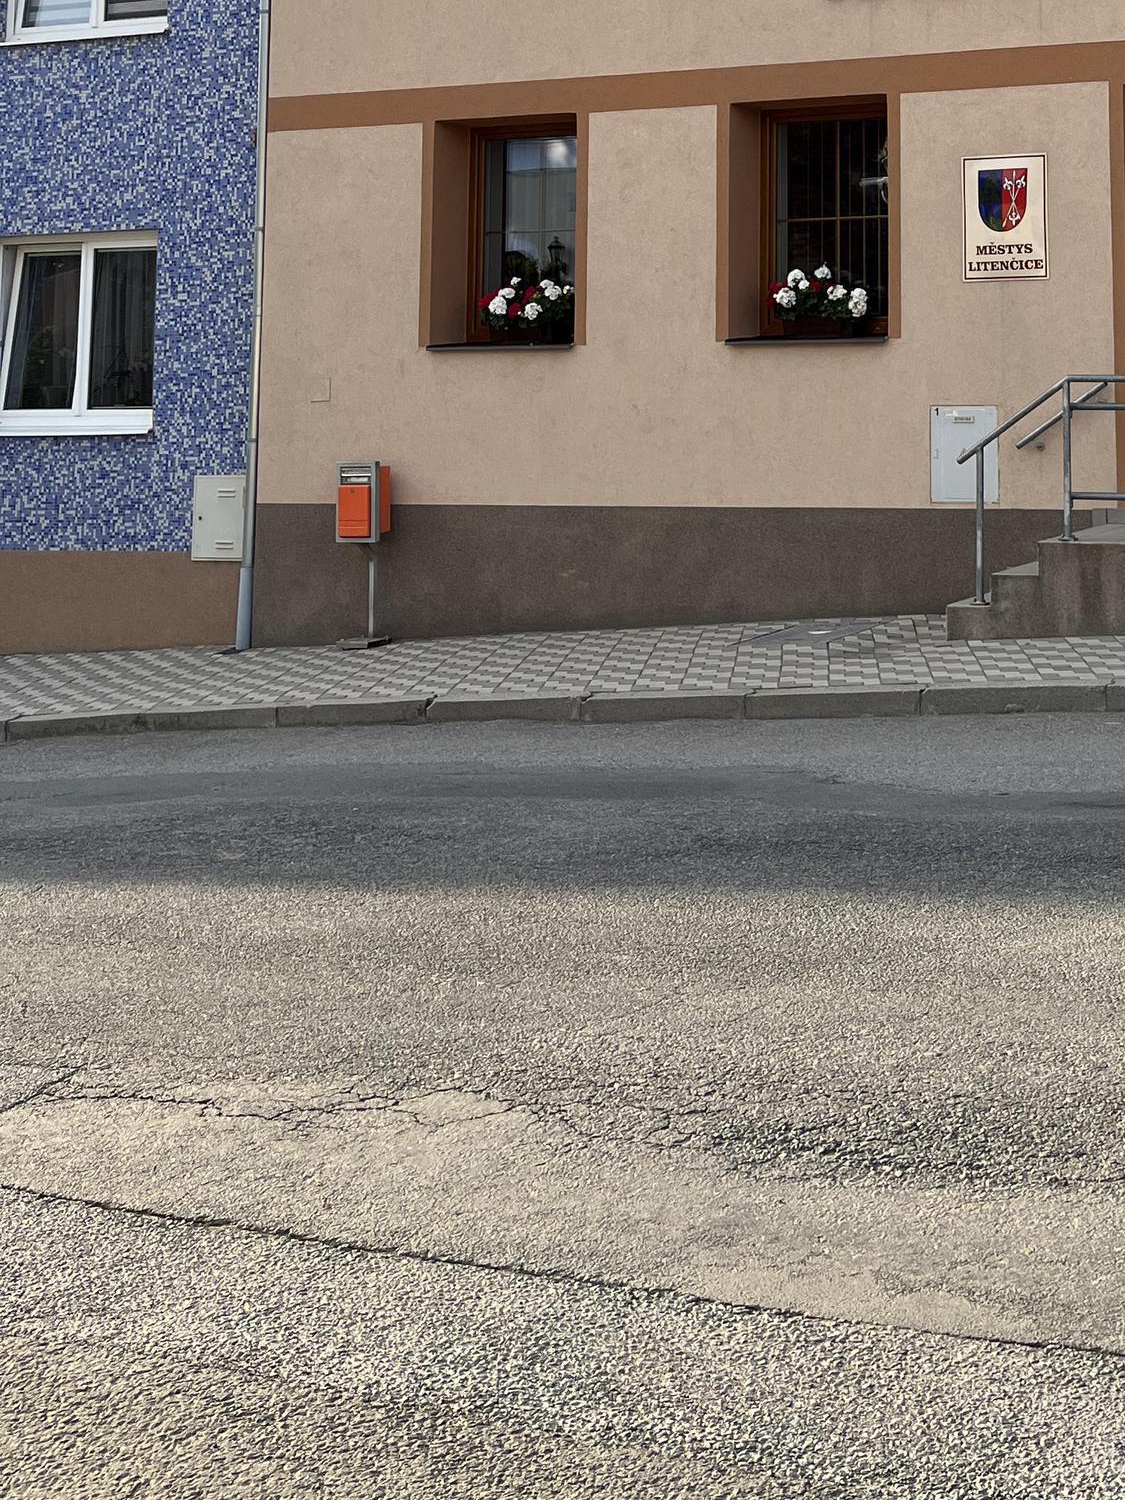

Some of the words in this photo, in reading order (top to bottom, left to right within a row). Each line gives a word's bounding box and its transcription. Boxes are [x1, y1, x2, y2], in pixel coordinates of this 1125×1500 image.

[976, 241, 1033, 256] MĚSTYS
[968, 257, 1044, 272] LITENČICE
[934, 407, 939, 416] 1
